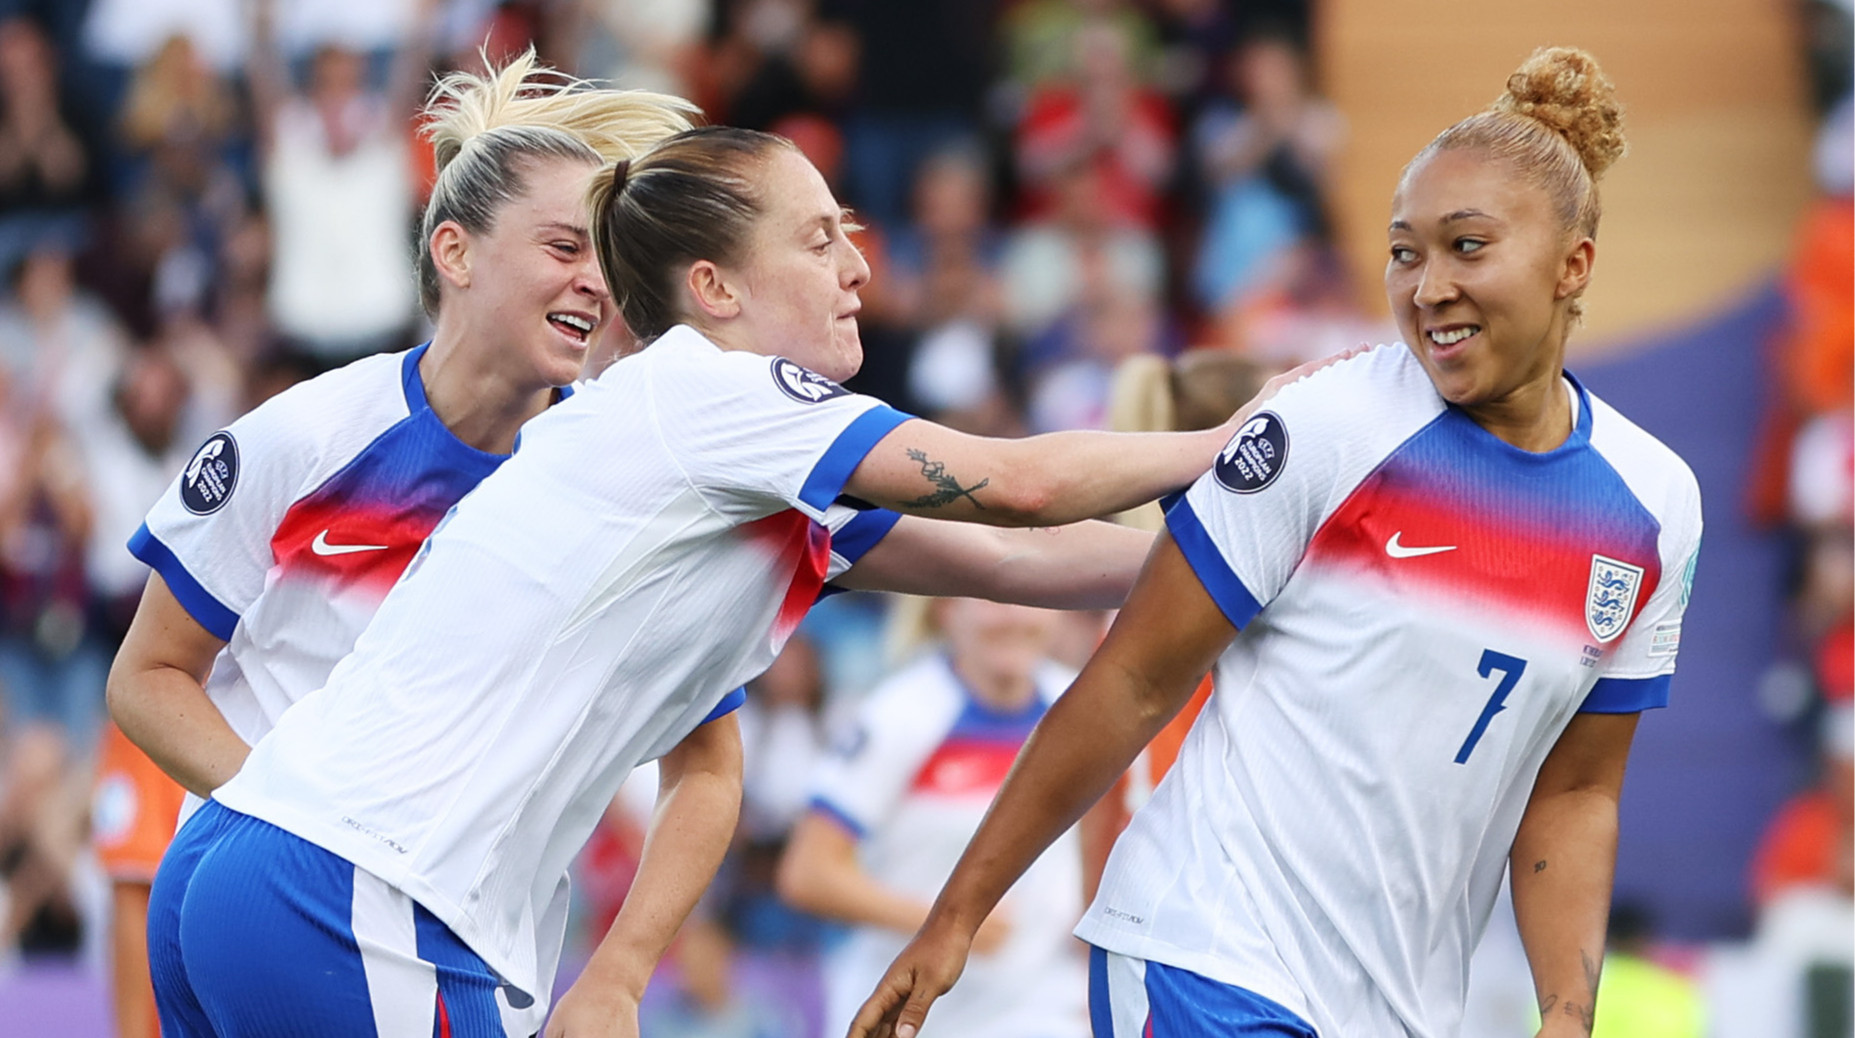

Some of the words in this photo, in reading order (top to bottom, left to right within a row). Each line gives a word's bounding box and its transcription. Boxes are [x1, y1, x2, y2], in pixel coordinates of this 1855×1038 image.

[1234, 457, 1254, 481] 2022
[1239, 444, 1267, 481] CHAMPIONS
[1246, 440, 1272, 474] EUROPEAN
[197, 480, 213, 503] 2022
[201, 467, 222, 501] CHAMPIONS
[206, 462, 226, 493] EUROPEAN
[1453, 648, 1528, 765] 7
